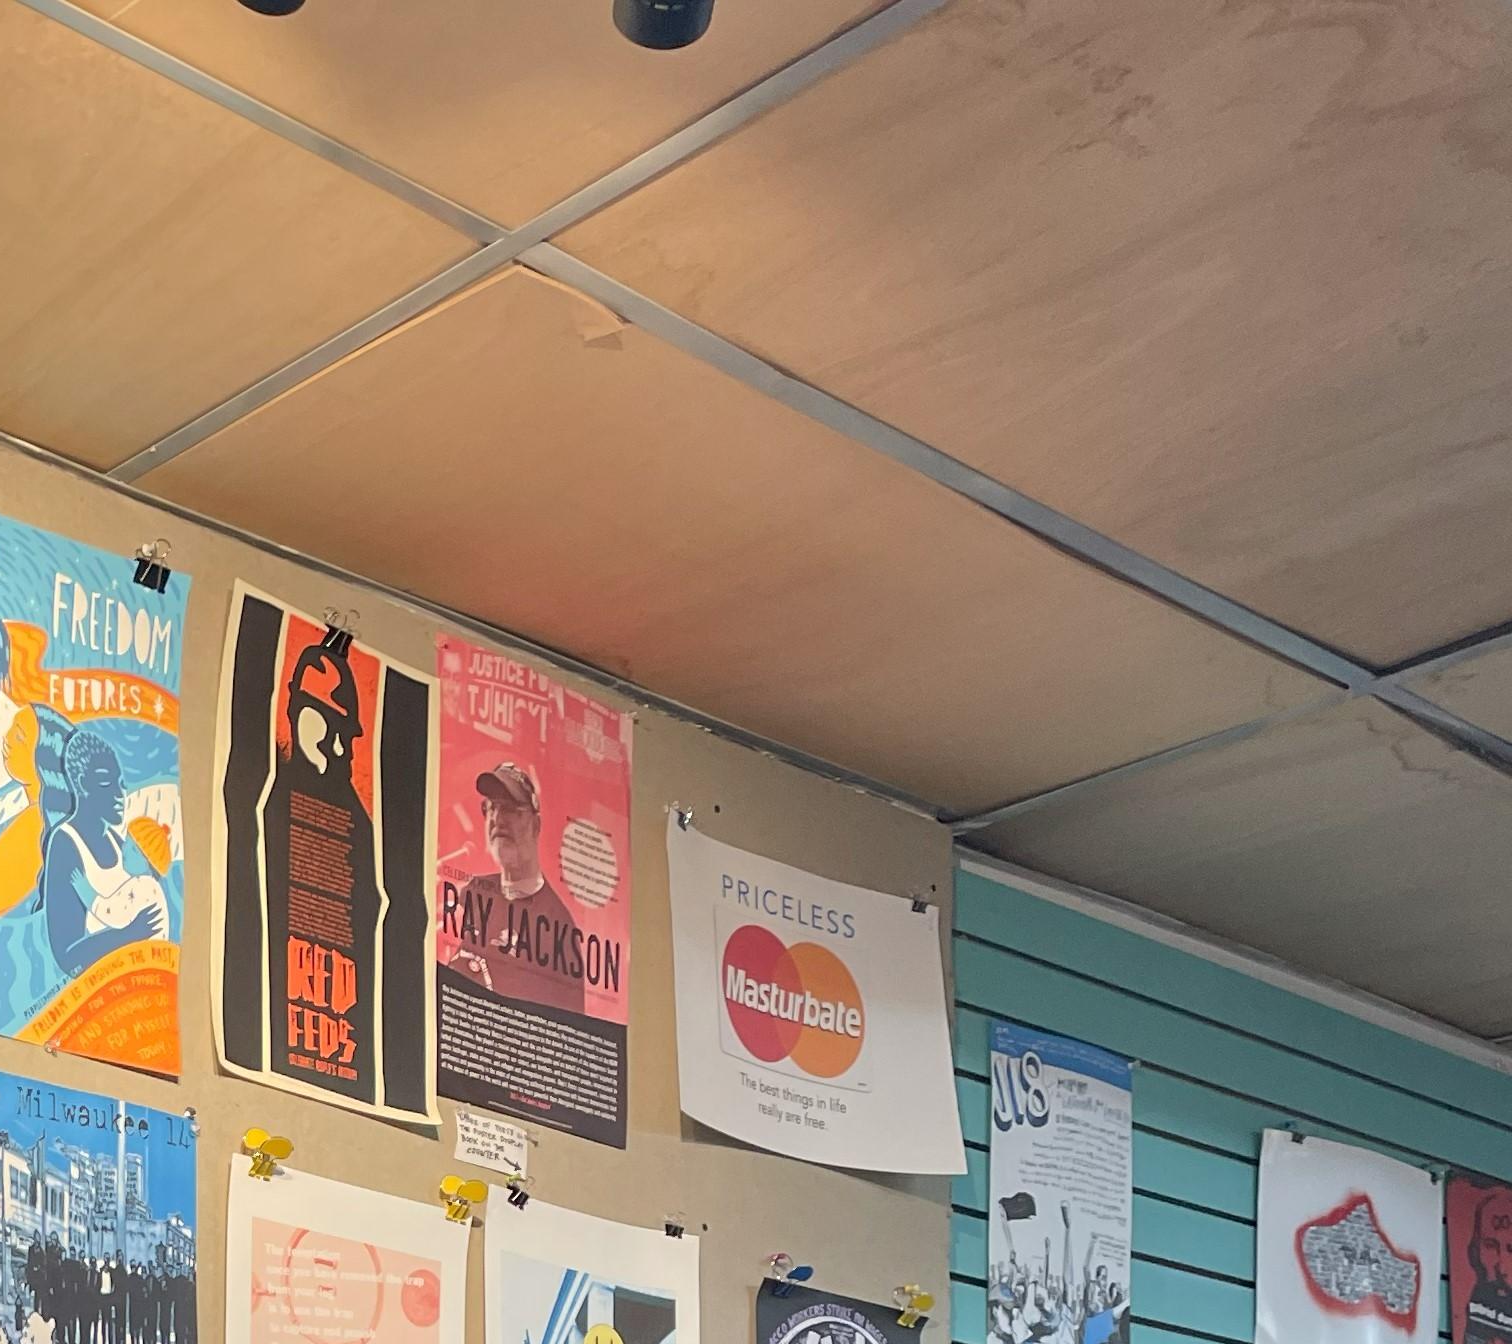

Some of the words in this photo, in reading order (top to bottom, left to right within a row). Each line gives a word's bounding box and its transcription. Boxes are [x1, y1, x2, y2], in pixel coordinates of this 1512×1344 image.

[52, 571, 173, 673] FREEDOM
[49, 675, 142, 714] FUTURES
[443, 881, 493, 939] RAY
[502, 901, 620, 993] JACKSON
[722, 874, 855, 938] PRICELESS
[726, 964, 862, 1038] Masturbate
[17, 1085, 149, 1141] Milwaukee
[166, 1117, 191, 1148] 14
[740, 1071, 756, 1090] The
[760, 1079, 780, 1098] best
[783, 1087, 813, 1109] things
[817, 1096, 827, 1110] in
[829, 1097, 847, 1114] life
